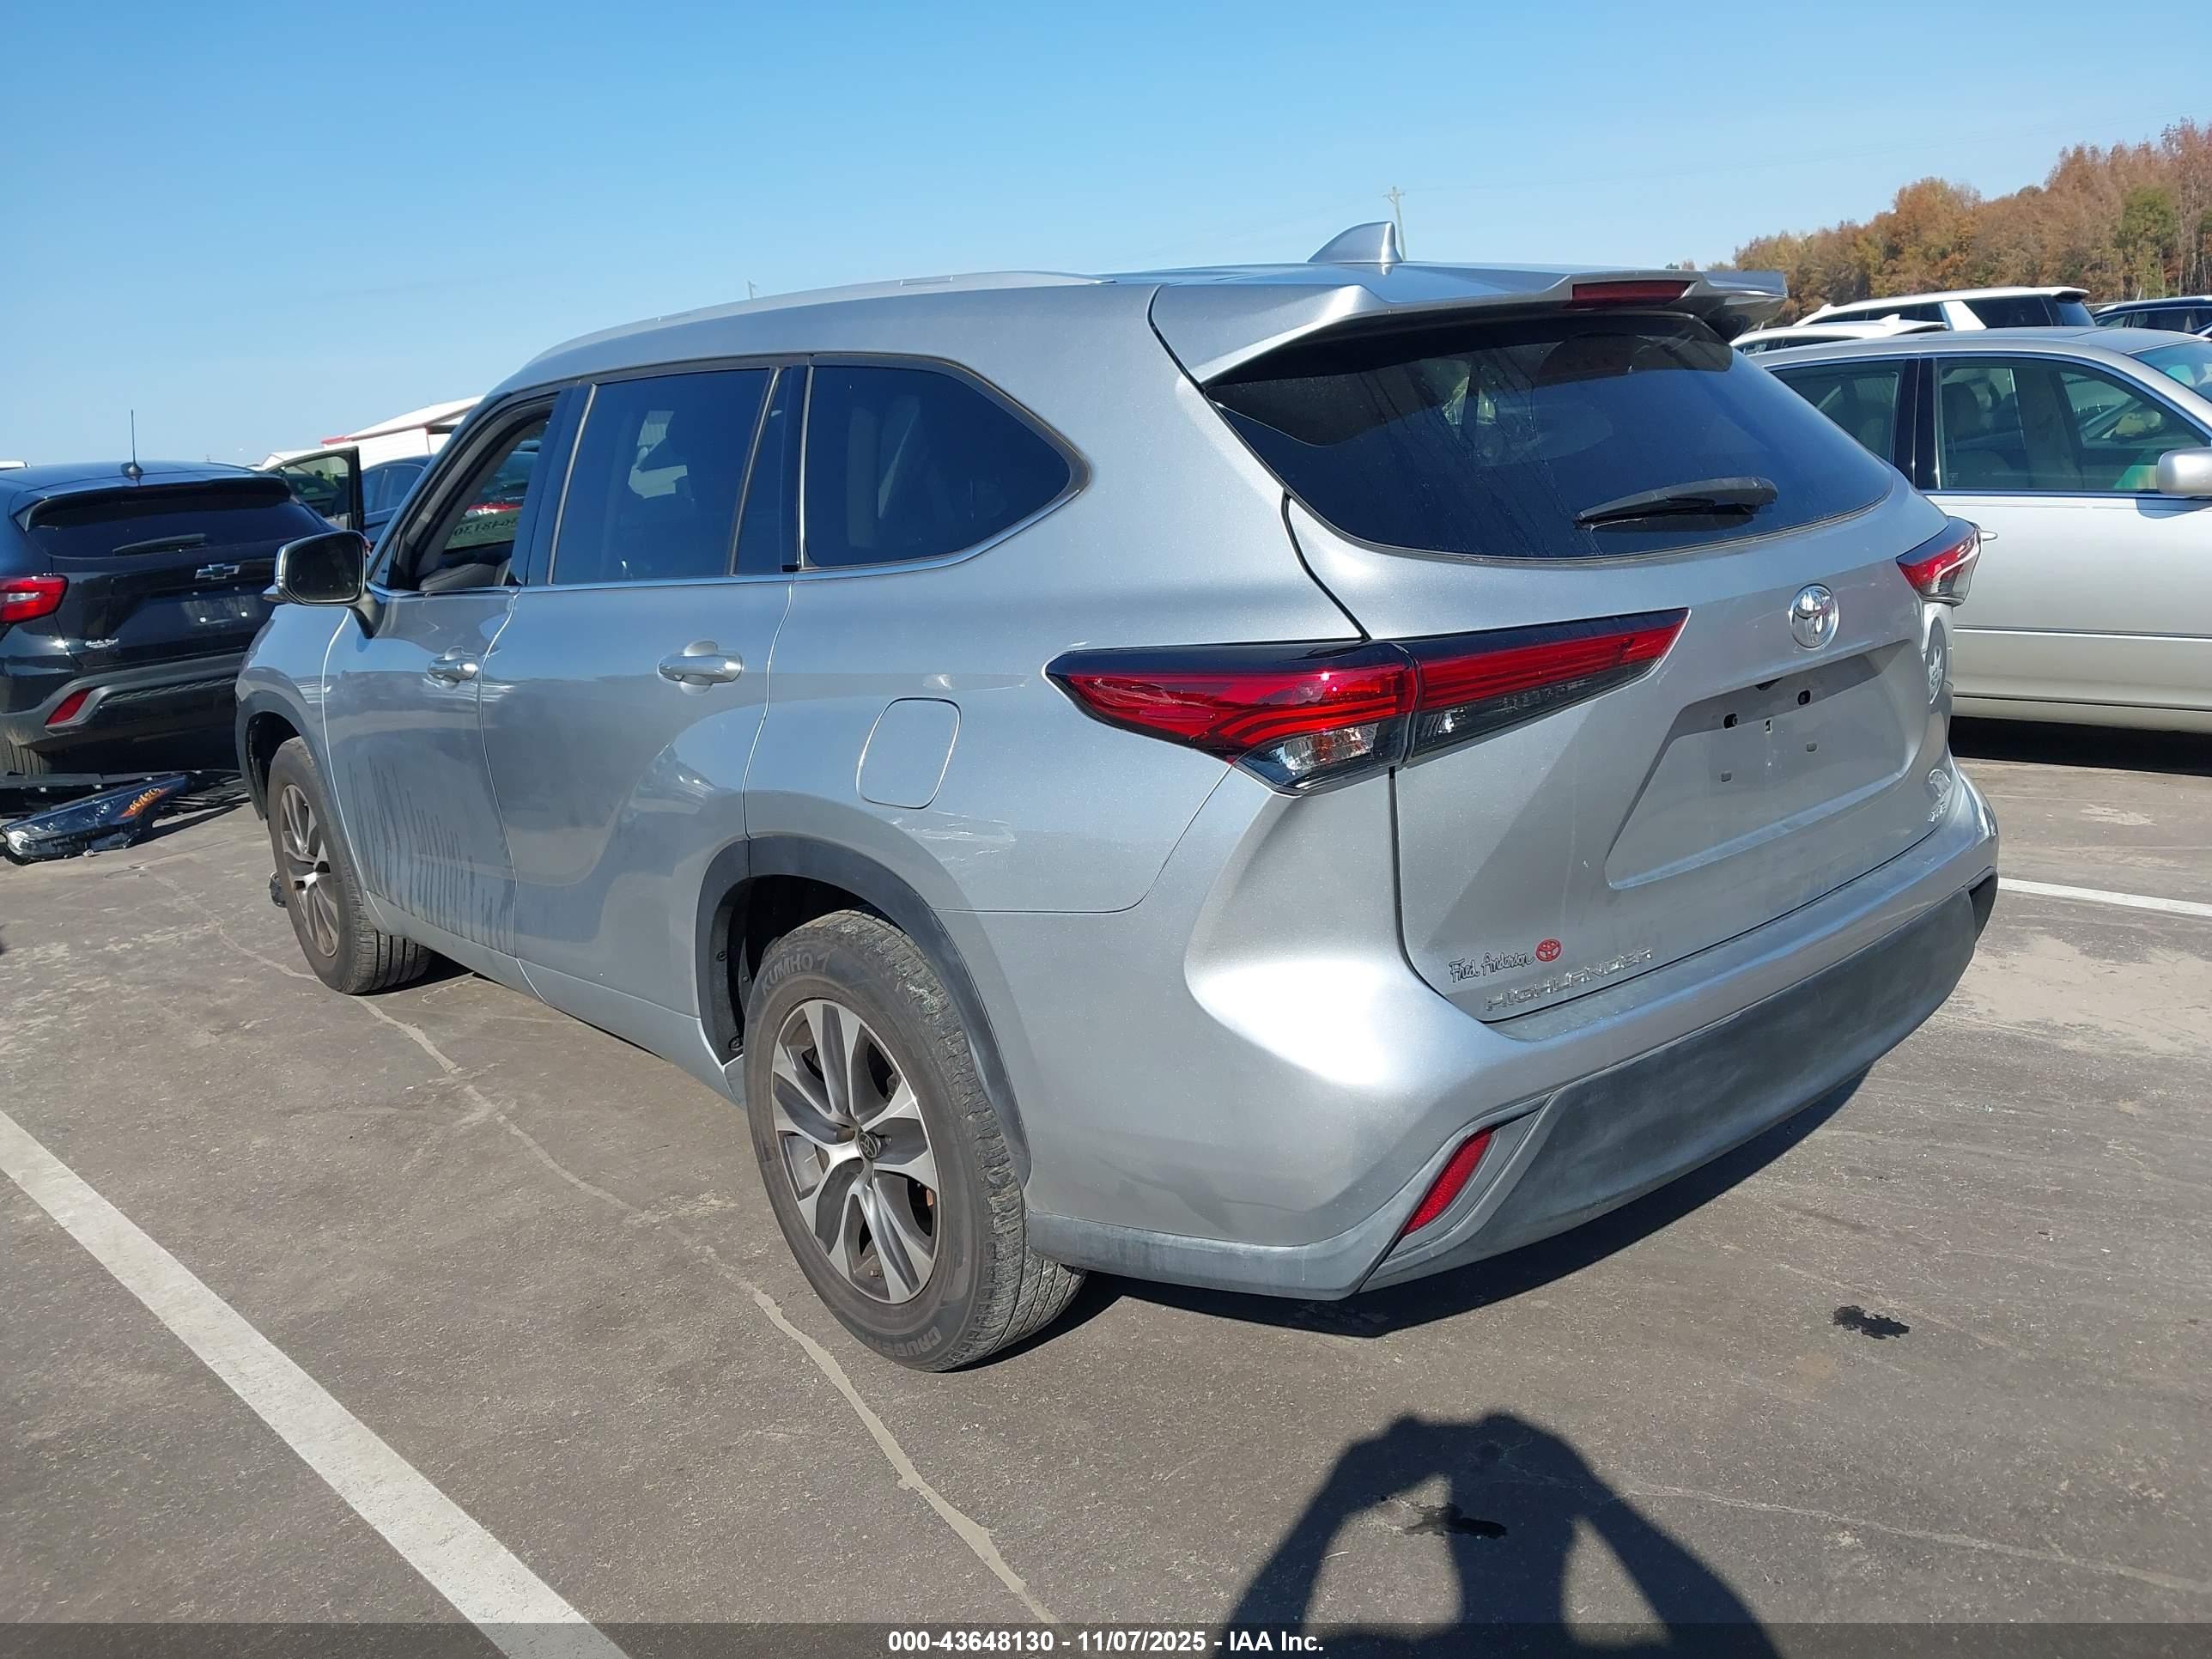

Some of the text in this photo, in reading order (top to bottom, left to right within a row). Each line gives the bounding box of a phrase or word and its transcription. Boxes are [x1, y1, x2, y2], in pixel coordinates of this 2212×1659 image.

[761, 952, 814, 997] KUMHO
[1448, 951, 1535, 983] Fred Anderson
[1484, 945, 1653, 1012] HIGHLANDER
